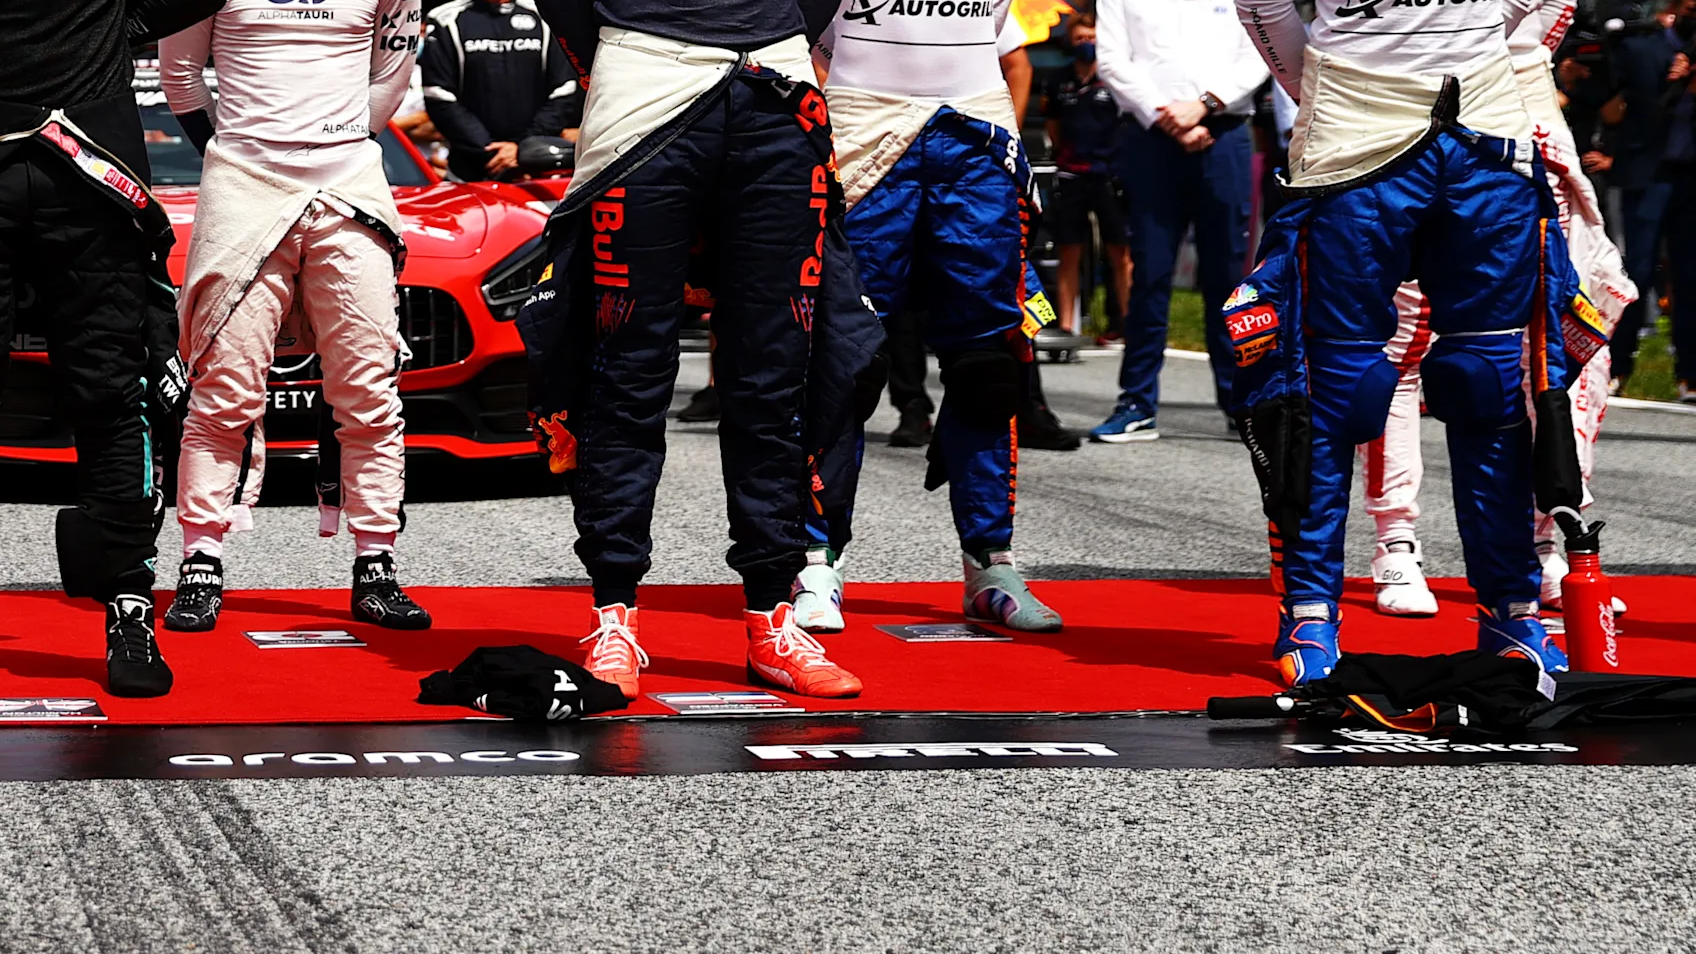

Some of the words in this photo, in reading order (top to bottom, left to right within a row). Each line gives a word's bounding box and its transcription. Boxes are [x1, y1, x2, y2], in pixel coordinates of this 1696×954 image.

[257, 10, 335, 20] ALPHATAURI
[888, 0, 993, 18] AUTOGRIL
[464, 40, 512, 53] SAFETY
[513, 38, 541, 51] CAR
[538, 289, 556, 302] App
[1382, 569, 1403, 581] GIO
[1598, 600, 1619, 668] Coca-Cola
[743, 742, 1122, 760] PIRELLI
[1282, 742, 1579, 754] Emirates
[167, 749, 582, 766] aramco
